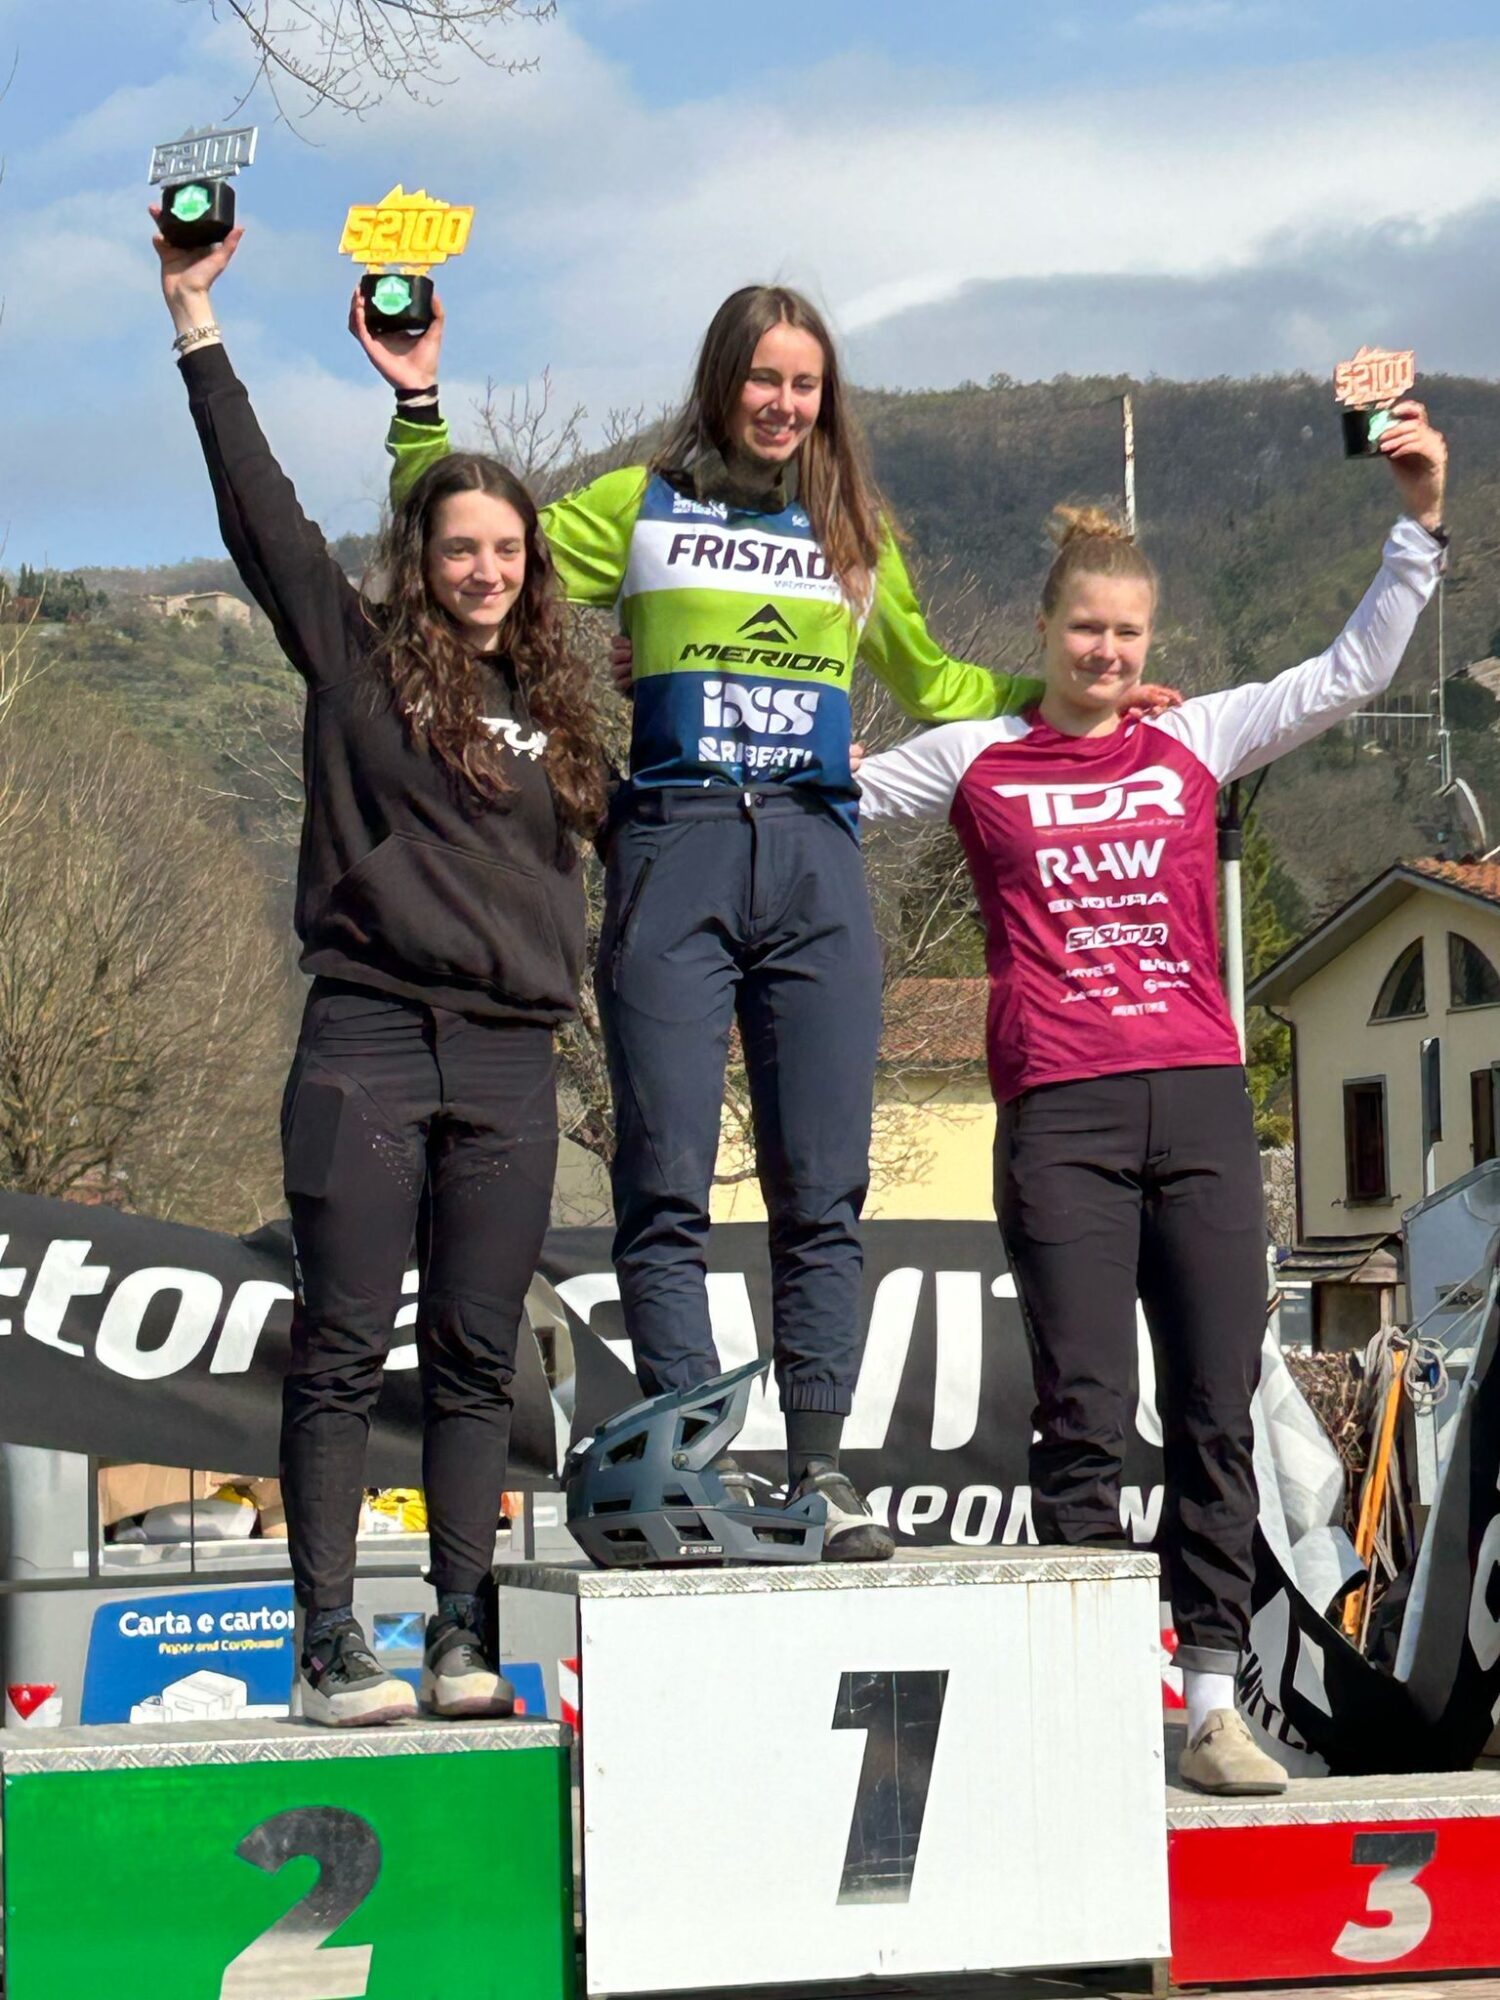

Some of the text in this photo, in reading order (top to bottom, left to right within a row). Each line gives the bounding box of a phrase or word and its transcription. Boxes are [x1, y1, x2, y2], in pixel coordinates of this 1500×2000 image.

[667, 533, 839, 581] FRISTAD
[679, 643, 845, 677] MERIDA
[991, 765, 1185, 827] TDR
[118, 1610, 192, 1637] Carta
[196, 1612, 215, 1633] e
[831, 1670, 950, 1905] 1
[219, 1805, 384, 2000] 2
[1331, 1829, 1439, 1964] 3
